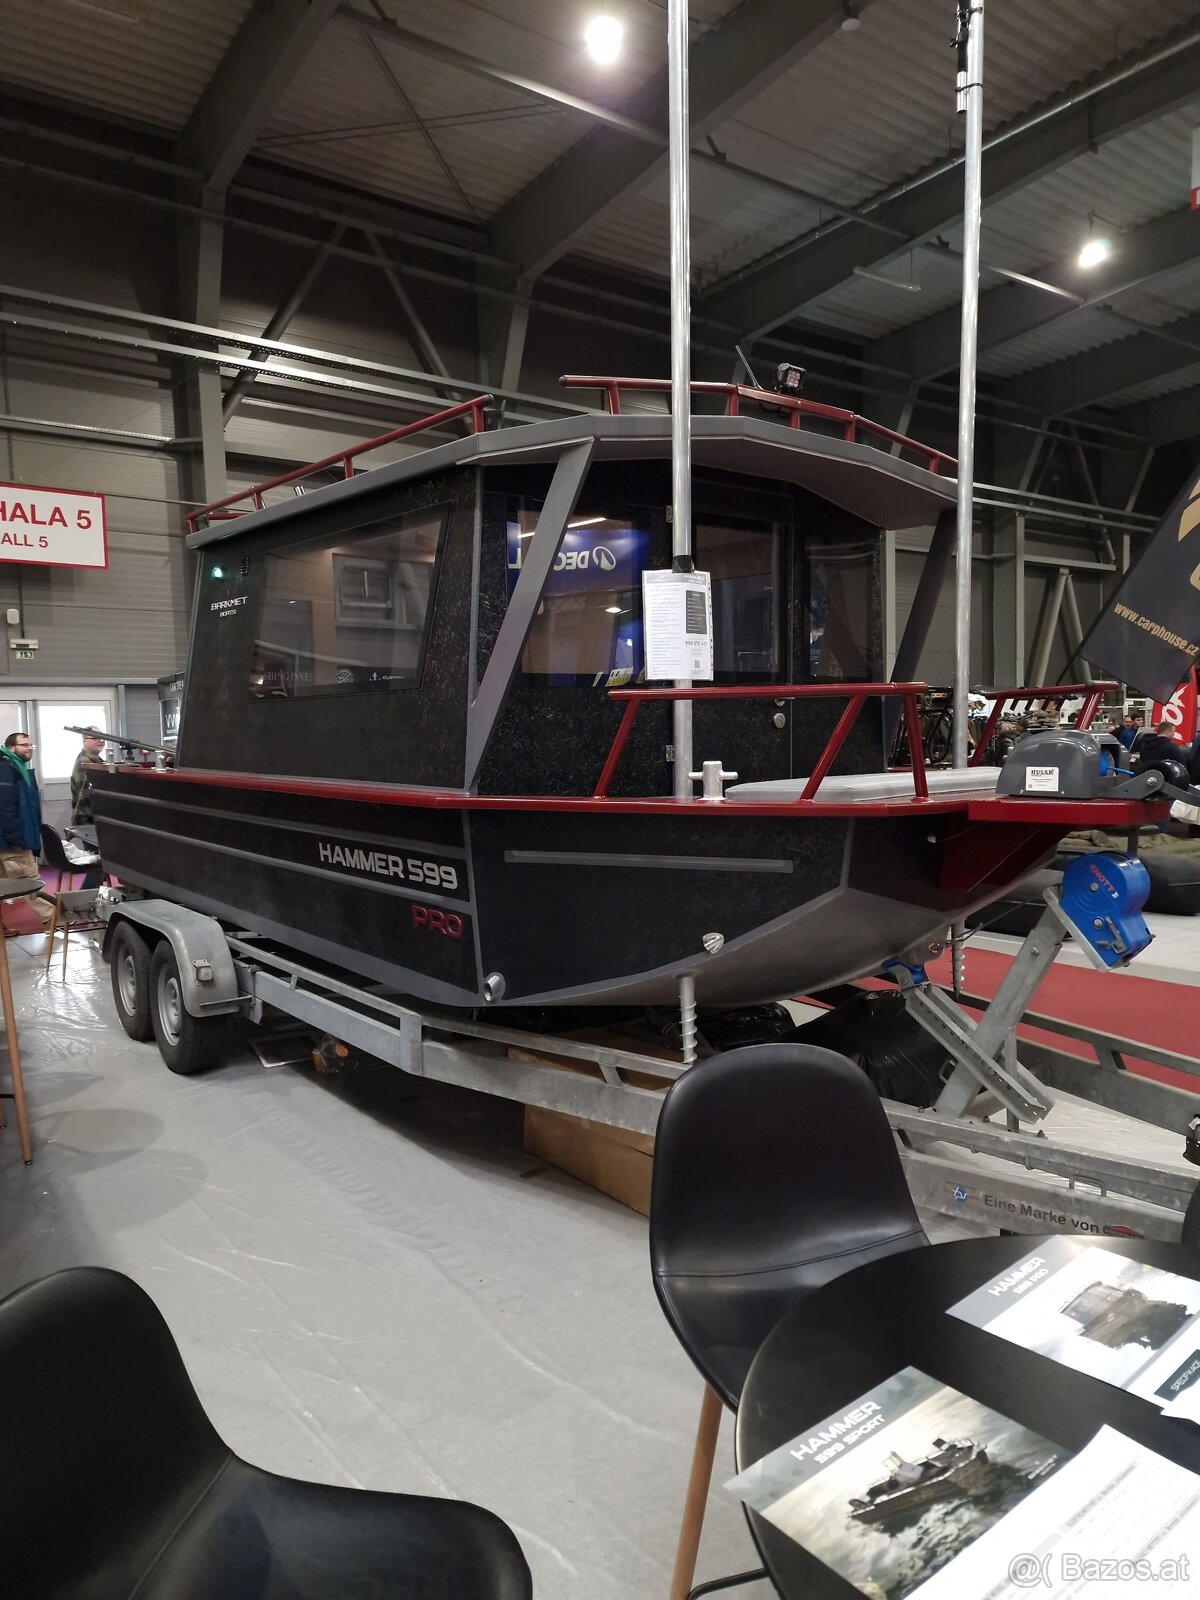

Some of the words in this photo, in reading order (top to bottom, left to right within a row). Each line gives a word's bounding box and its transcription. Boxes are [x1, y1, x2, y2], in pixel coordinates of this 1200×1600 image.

[76, 509, 92, 530] 5
[0, 532, 34, 547] ALL
[38, 535, 49, 548] 5
[1113, 602, 1200, 657] www.carphouse.cz
[318, 842, 405, 879] HAMMER
[406, 859, 458, 890] 599
[1089, 864, 1116, 892] KNOTT
[411, 904, 463, 938] PRO
[984, 1194, 1016, 1213] Eine
[1019, 1203, 1067, 1225] Marke
[1071, 1218, 1100, 1234] von
[987, 1256, 1047, 1297] HAMMER
[1028, 1268, 1049, 1283] PRO
[789, 1400, 882, 1461] HAMMER
[813, 1442, 846, 1464] 599
[842, 1414, 885, 1445] SPORT
